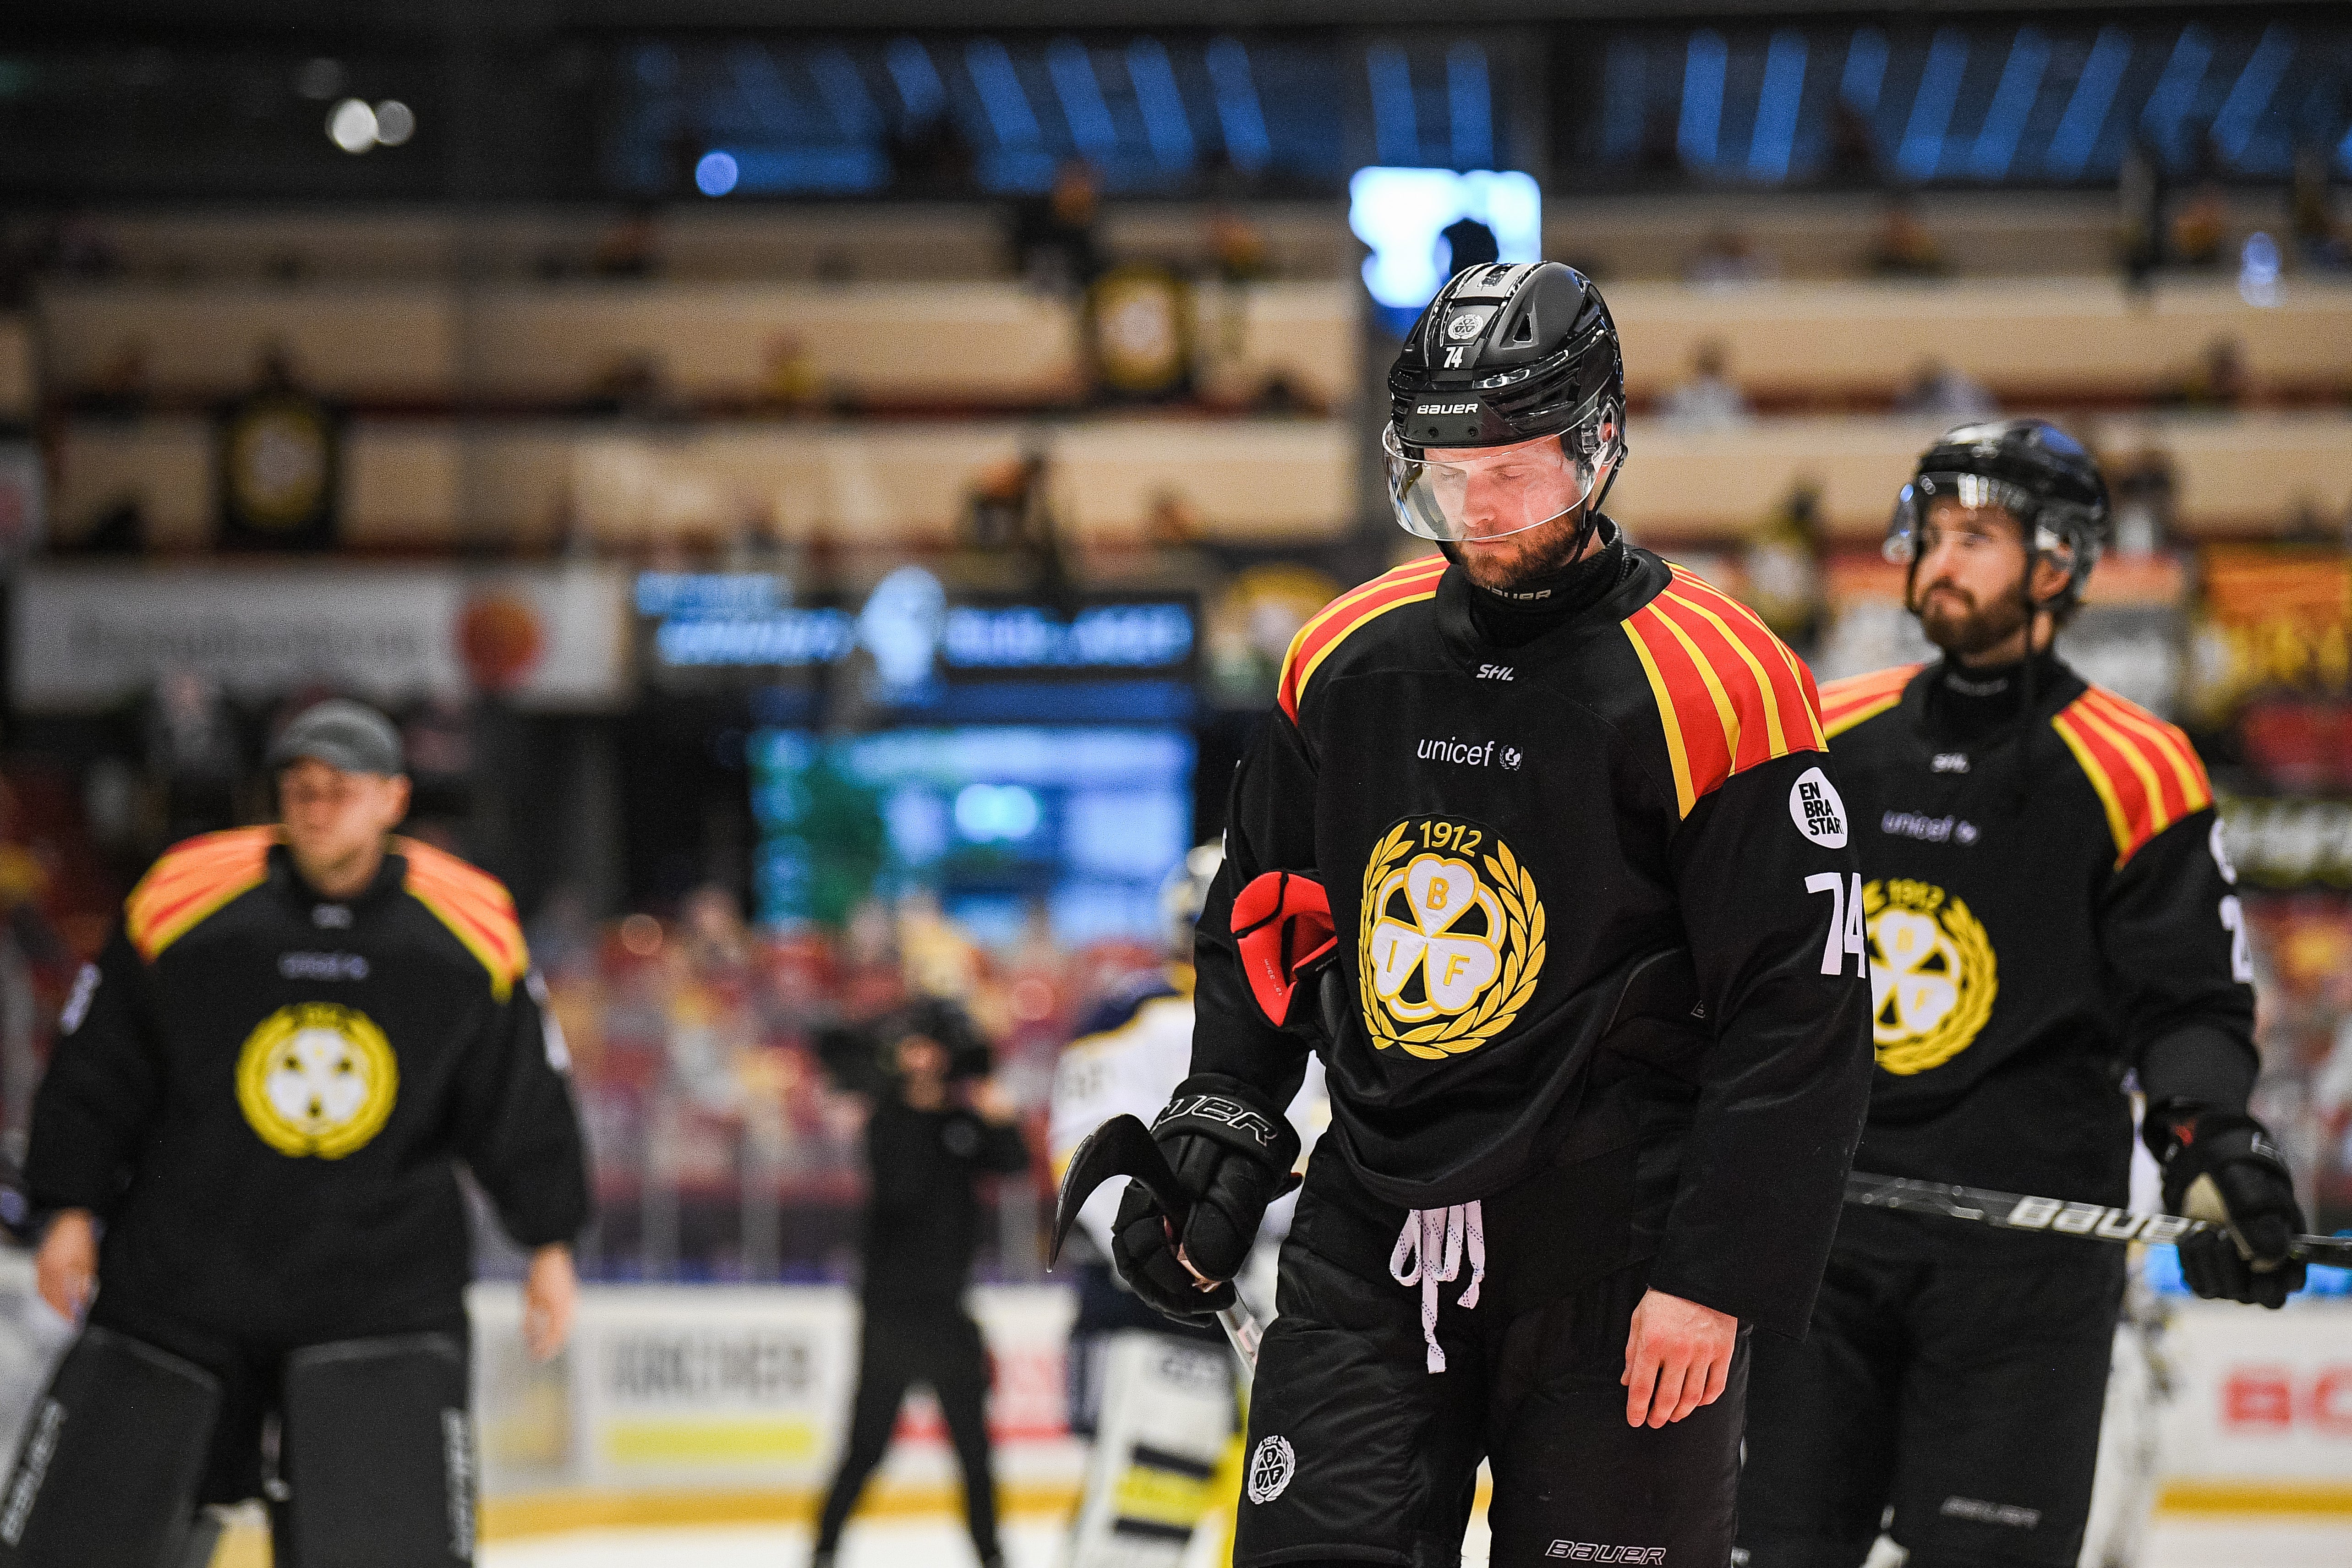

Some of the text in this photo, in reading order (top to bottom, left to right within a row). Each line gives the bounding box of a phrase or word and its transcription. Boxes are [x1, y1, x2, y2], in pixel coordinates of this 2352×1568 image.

[1444, 346, 1464, 368] 74
[1417, 403, 1478, 414] BAUER
[1476, 664, 1514, 681] SHL
[1417, 737, 1495, 767] unicef
[1798, 781, 1821, 801] EN
[1803, 799, 1834, 819] BRA
[1420, 820, 1482, 857] 1912
[1808, 817, 1845, 836] STAR
[1427, 876, 1449, 910] B
[1805, 872, 1866, 979] 74
[1386, 940, 1398, 973] I
[1443, 953, 1470, 986] F
[2008, 1195, 2207, 1243] BAUE
[1264, 1435, 1278, 1445] 1912
[1545, 1539, 1667, 1565] BAUER
